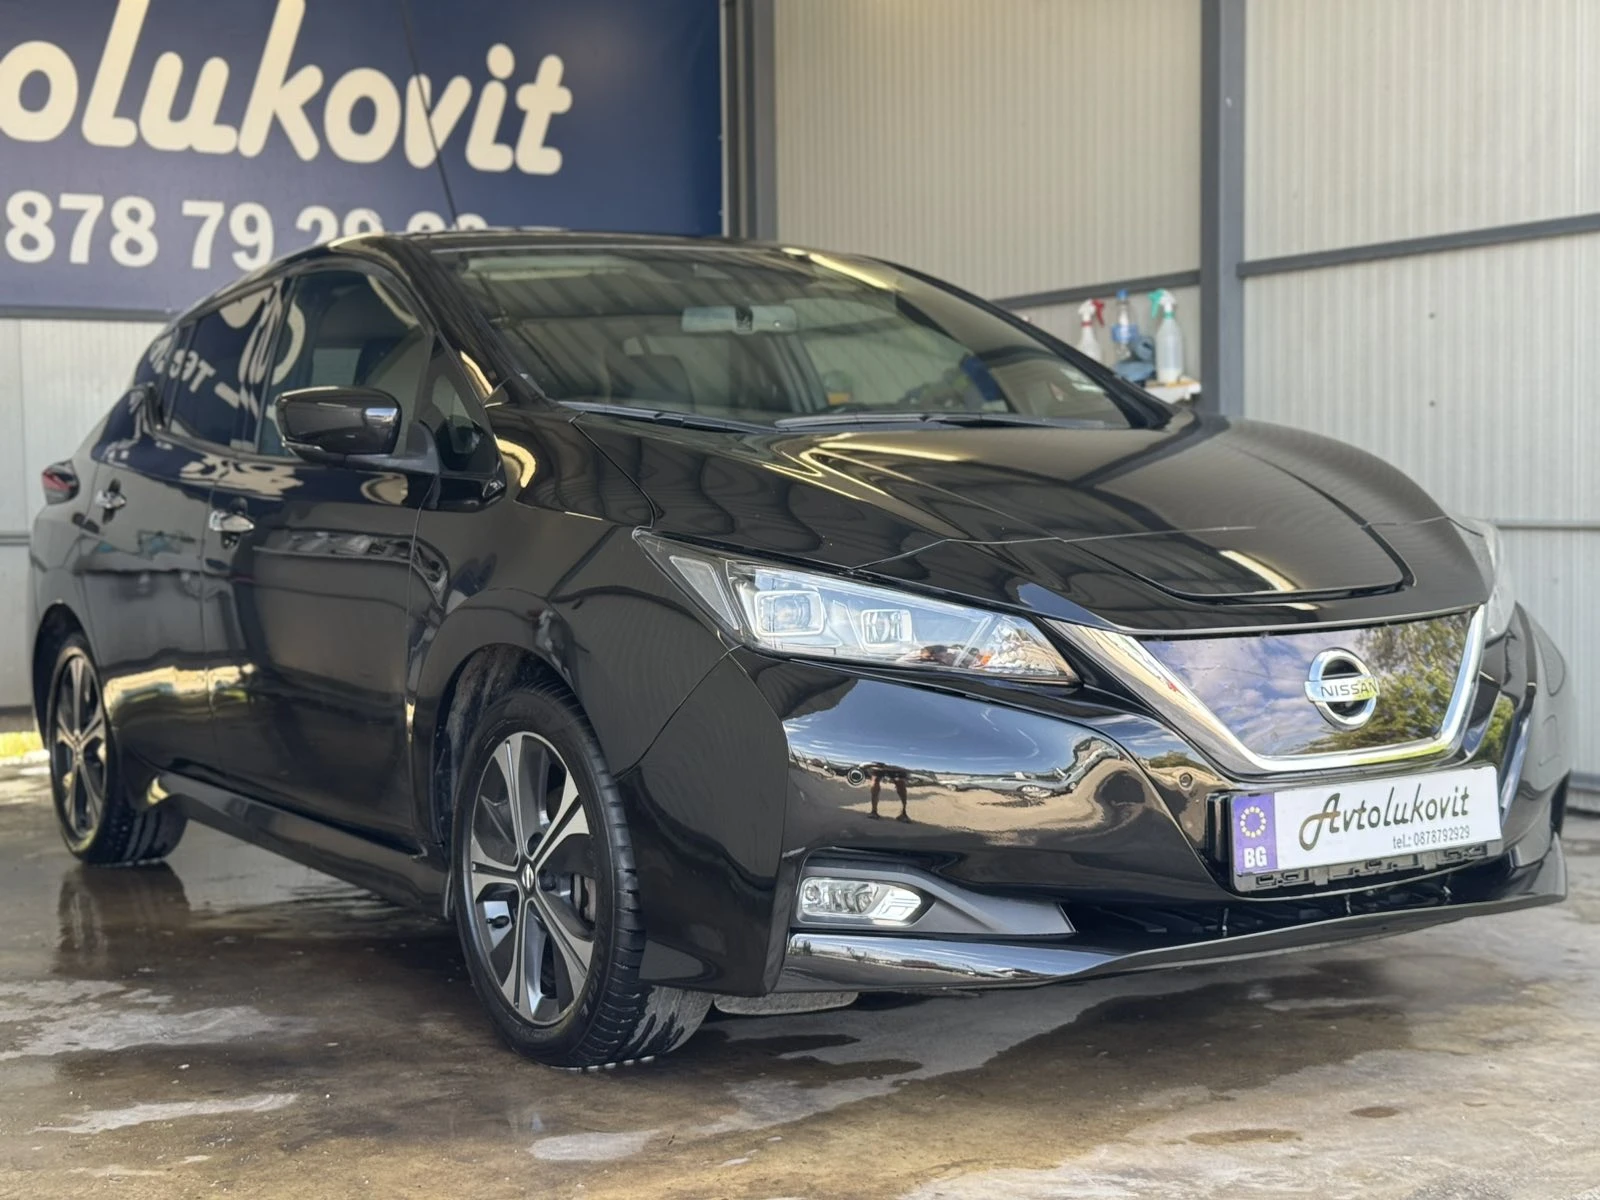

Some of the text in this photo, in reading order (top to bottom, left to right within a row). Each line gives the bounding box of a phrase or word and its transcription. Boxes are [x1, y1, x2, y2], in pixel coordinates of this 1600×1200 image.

[5, 190, 158, 268] 878
[182, 199, 274, 271] 79
[1320, 682, 1377, 697] NISSAN
[1300, 784, 1469, 851] Avtolukovit
[1243, 846, 1267, 868] BG
